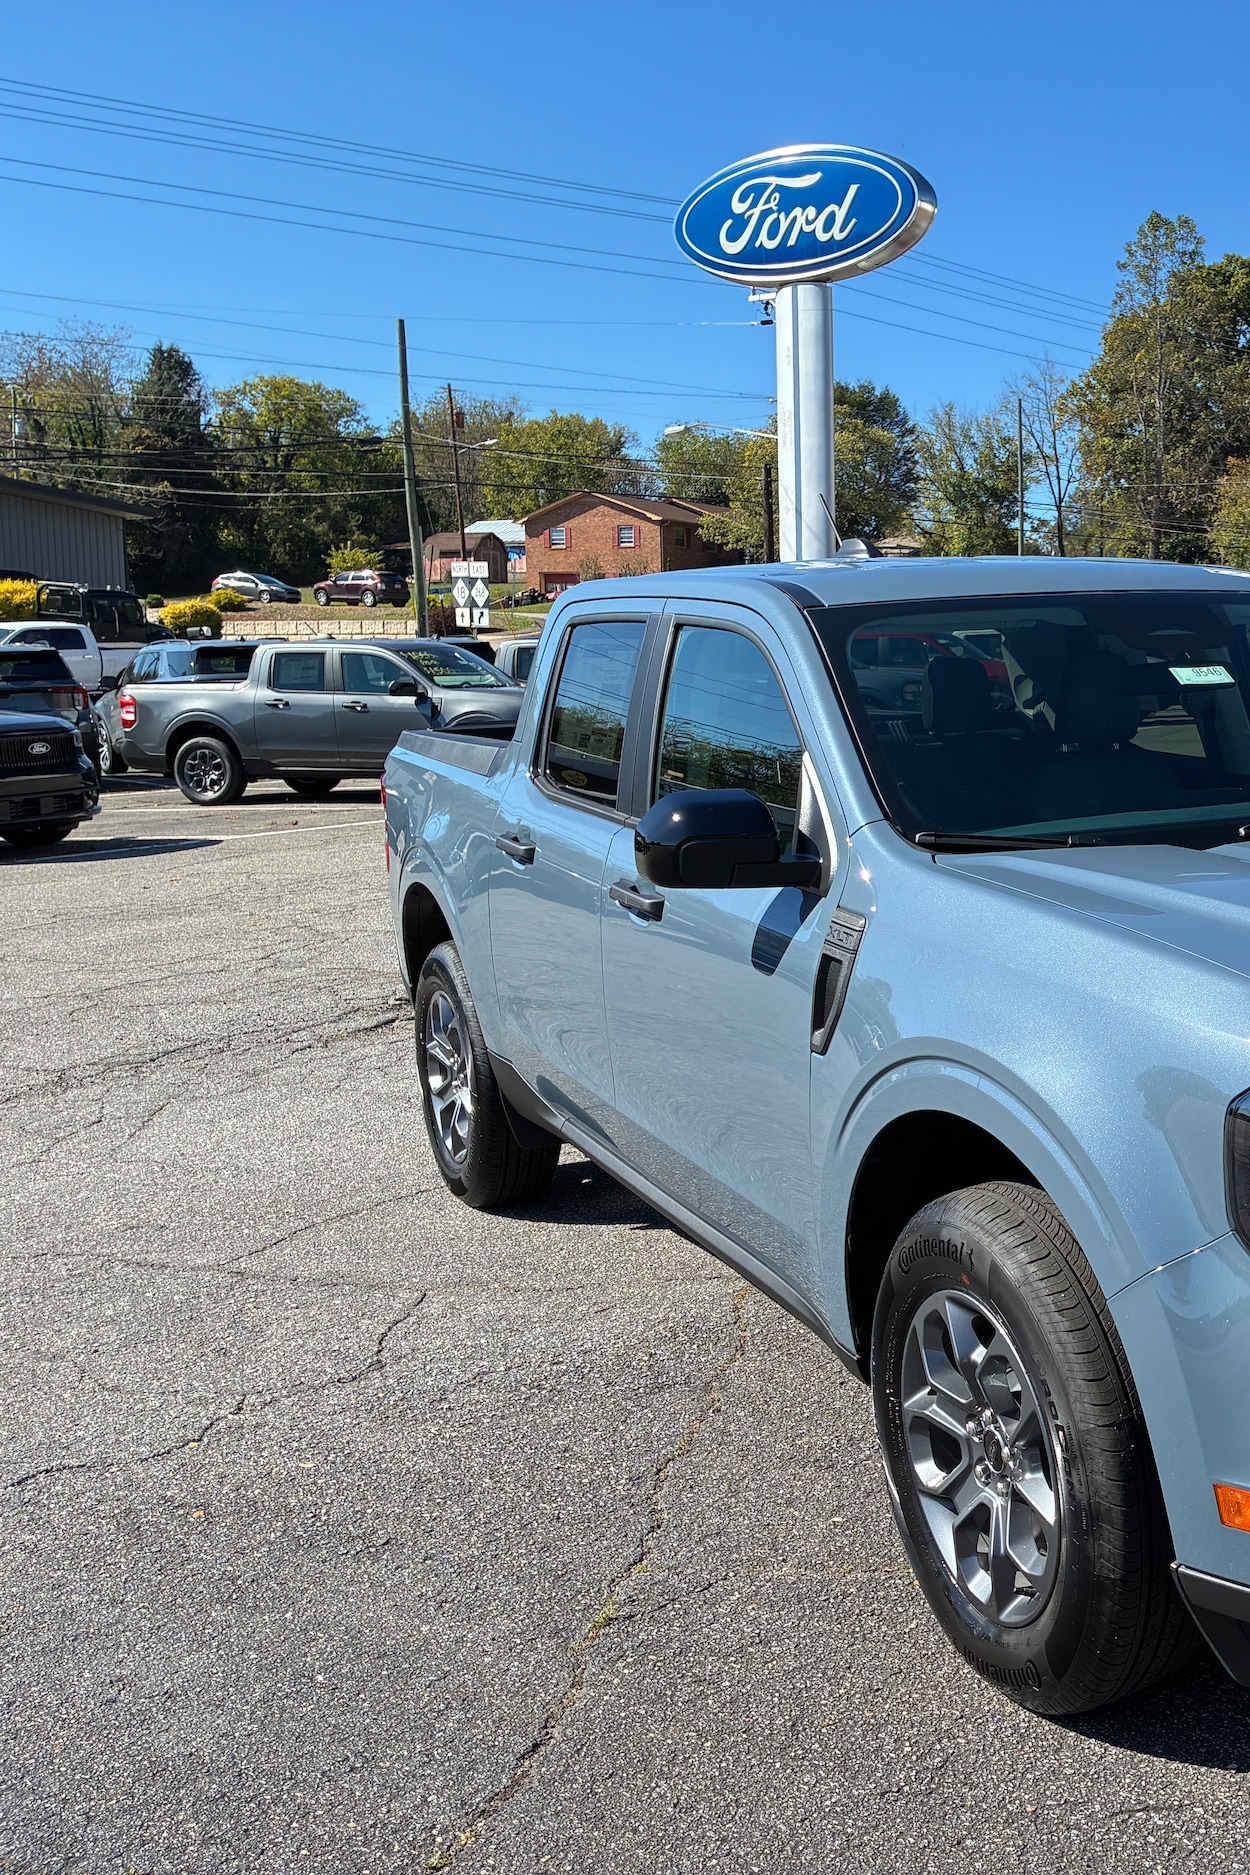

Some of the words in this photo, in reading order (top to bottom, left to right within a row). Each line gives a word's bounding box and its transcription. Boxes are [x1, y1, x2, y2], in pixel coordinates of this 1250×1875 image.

[719, 171, 860, 255] Ford
[452, 565, 467, 573] NORTH
[472, 565, 485, 574] EAST
[456, 586, 466, 599] 18
[474, 587, 486, 598] 268
[1191, 667, 1222, 677] 9546
[826, 925, 855, 945] XLT
[898, 1234, 965, 1275] Continental
